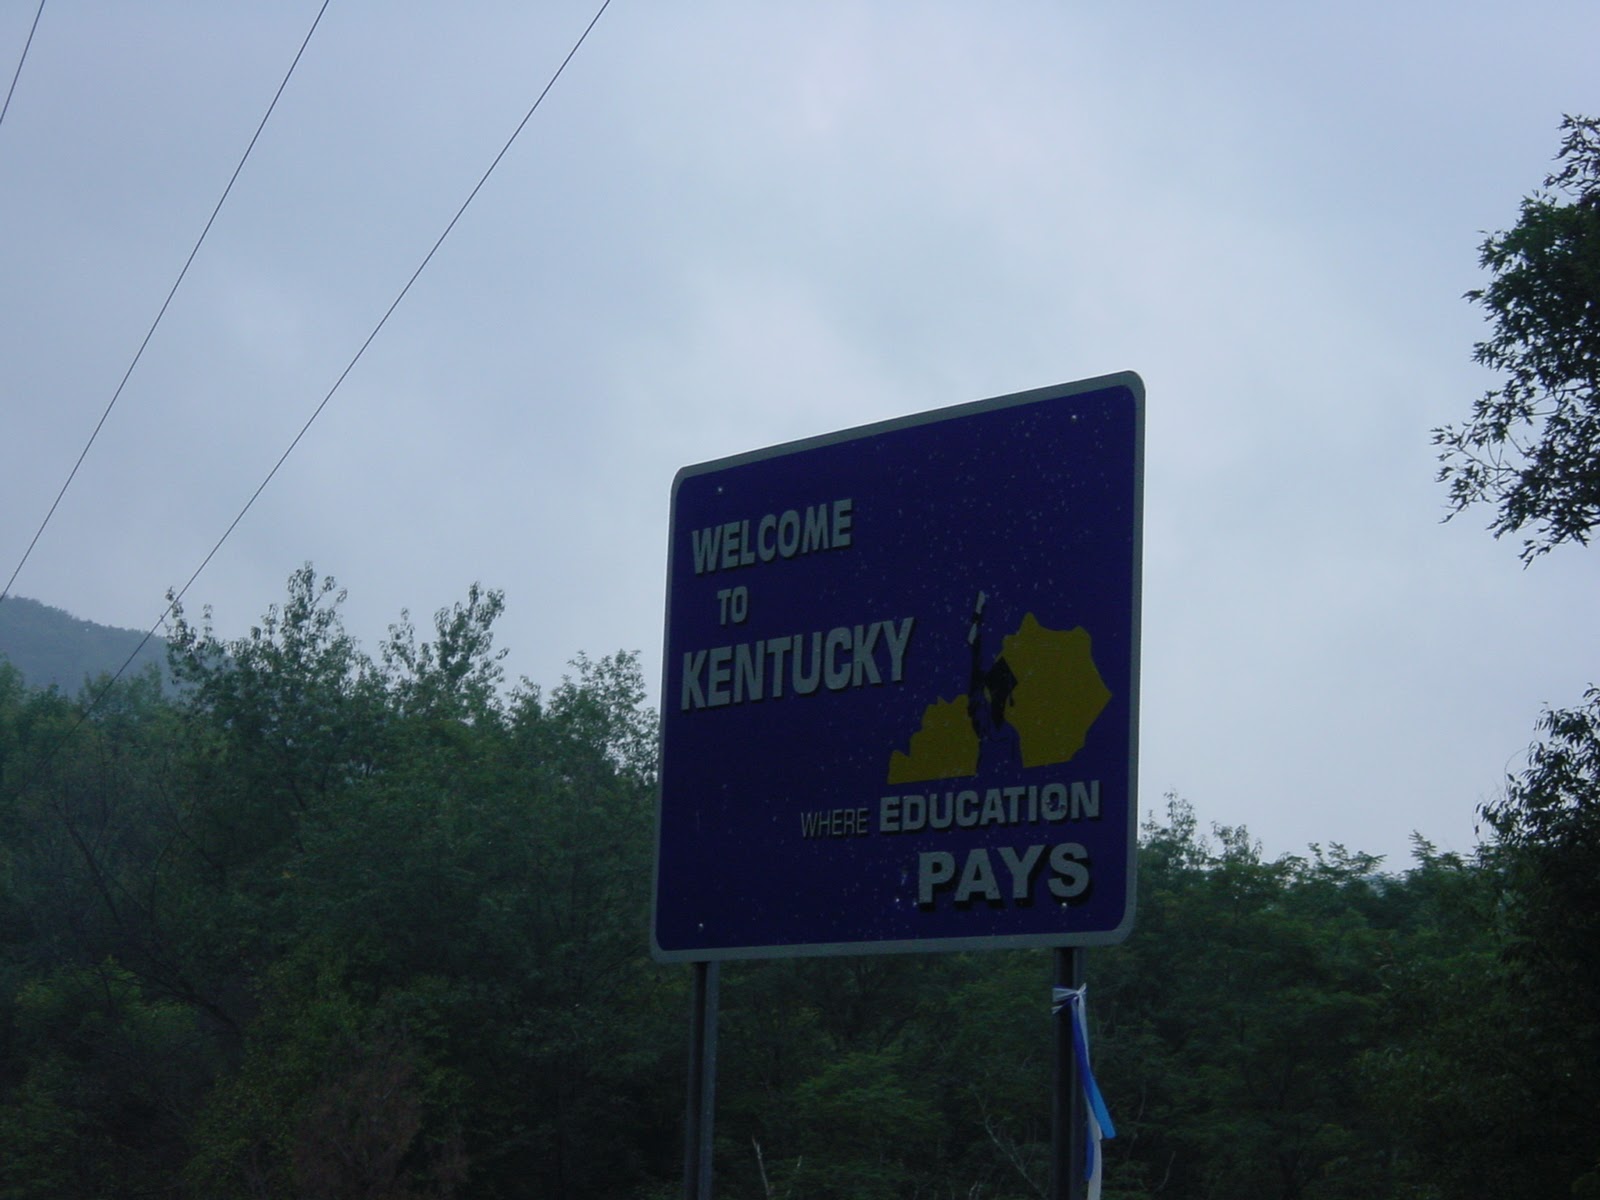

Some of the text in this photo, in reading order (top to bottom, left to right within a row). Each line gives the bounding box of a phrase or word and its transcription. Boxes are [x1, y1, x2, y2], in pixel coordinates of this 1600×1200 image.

[691, 498, 853, 575] WELCOME
[717, 586, 749, 626] TO
[680, 616, 915, 711] KENTUCKY
[800, 779, 1100, 838] WHERE EDUCATION
[918, 841, 1091, 904] PAYS
